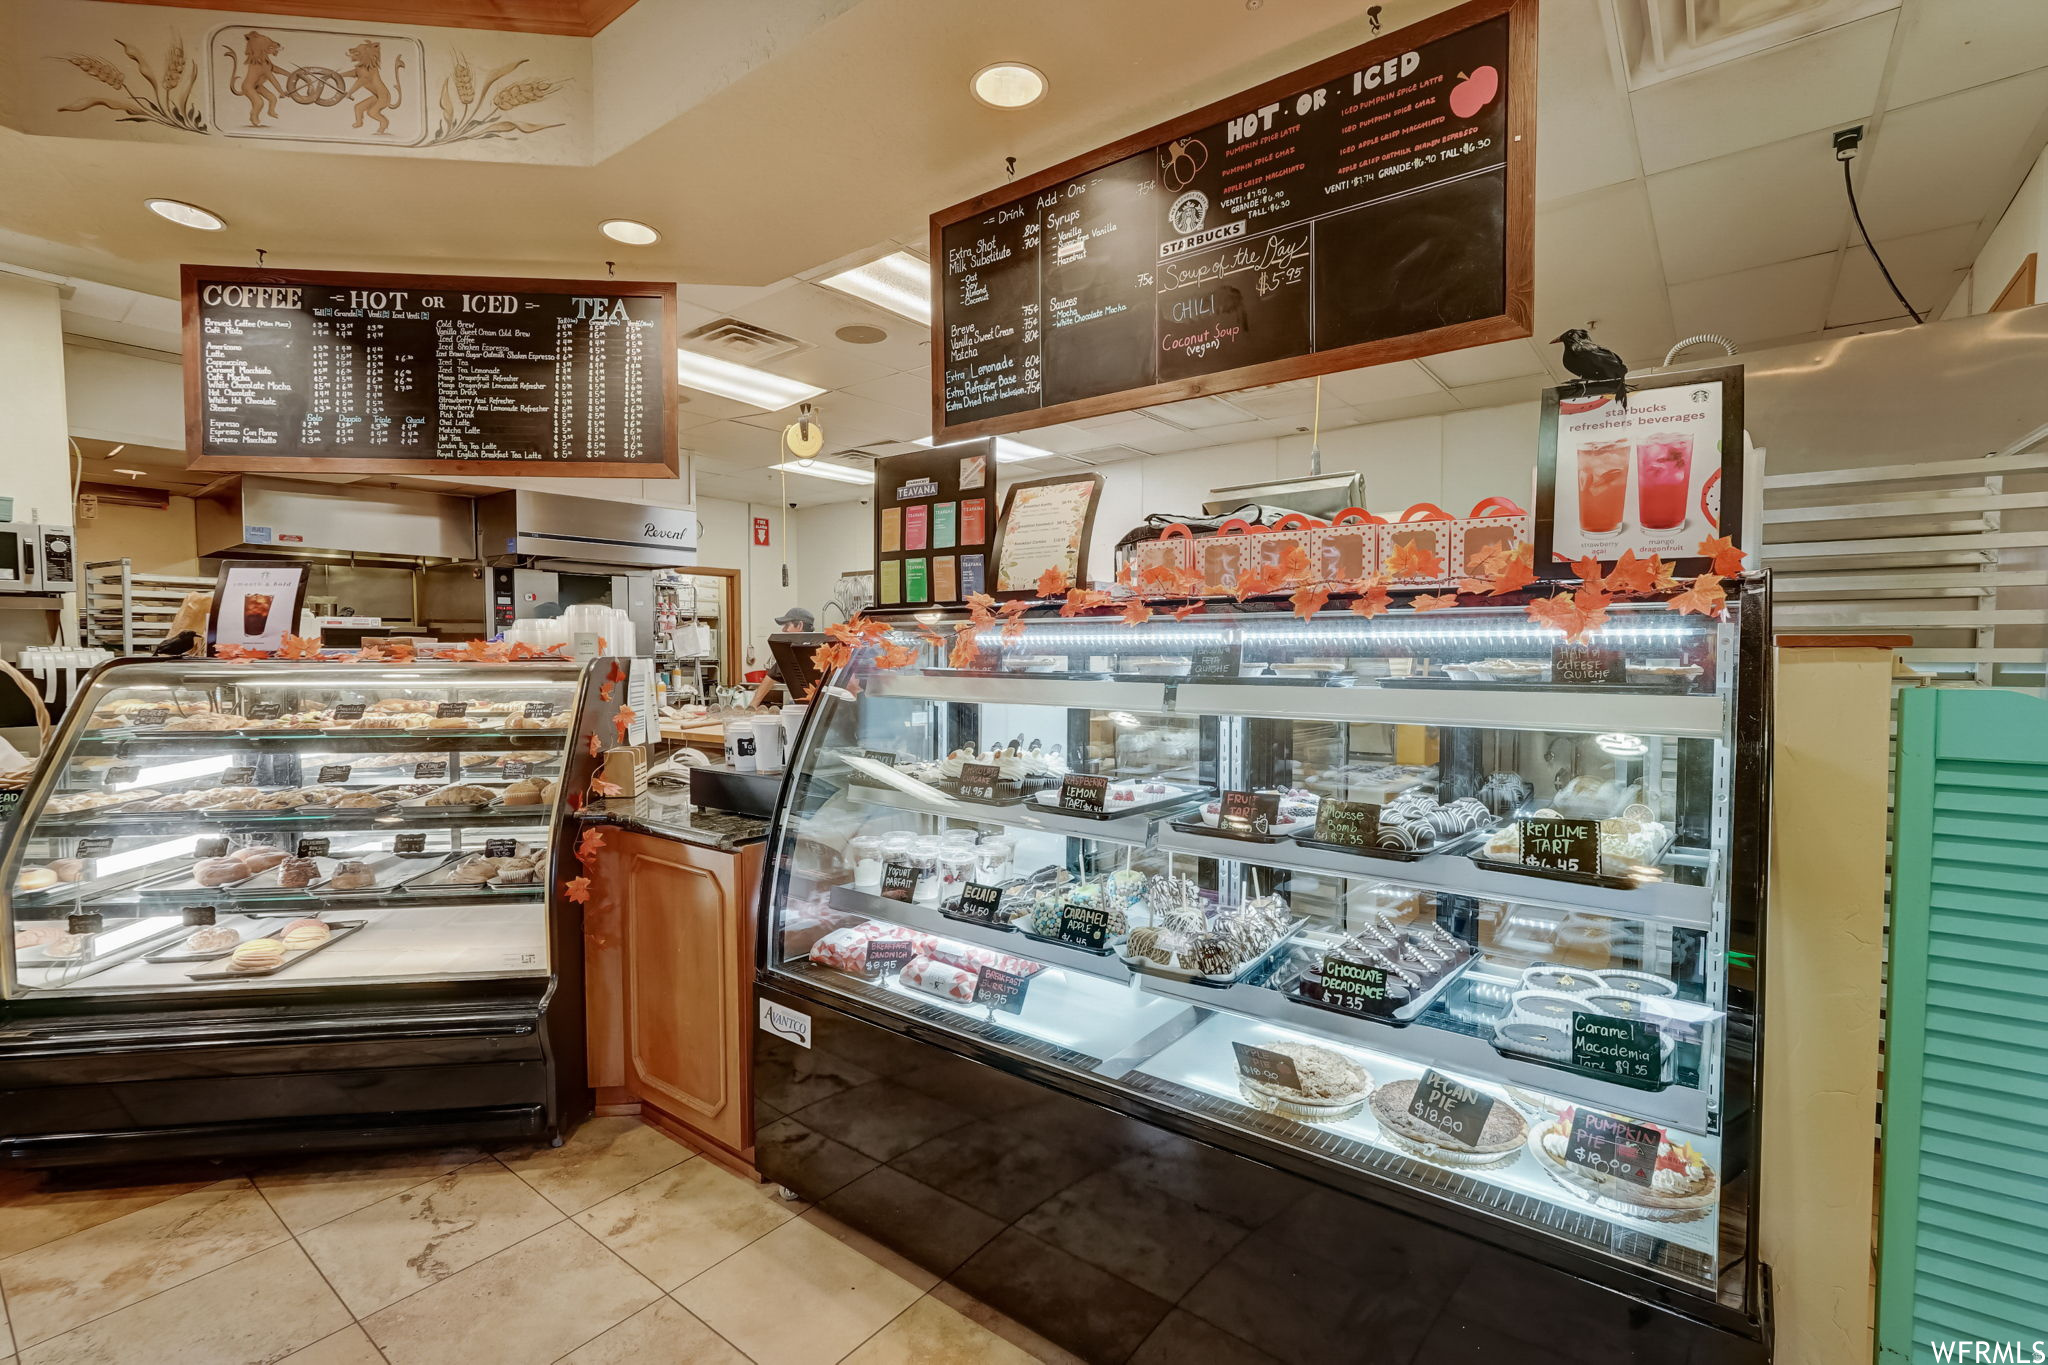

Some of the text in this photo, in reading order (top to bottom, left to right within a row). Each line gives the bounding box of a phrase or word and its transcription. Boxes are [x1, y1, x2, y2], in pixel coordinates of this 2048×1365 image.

[1227, 51, 1421, 145] HOT OR ICED
[1359, 74, 1444, 110] PUMPKIN SPICE LATTE
[1359, 103, 1413, 128] PUMPKIN SPICE
[1225, 123, 1301, 158] PUMPKIN SPICE LATTE
[1358, 116, 1446, 149] APPLE CRISP MACCHIATO
[1381, 126, 1479, 161] OATMILK ESPRESSO
[1222, 153, 1273, 177] PUMPKIN SPICE
[1223, 163, 1306, 194] APPLE CRISP MACCHIATO
[1324, 161, 1412, 195] VENTI GRANDE
[1220, 195, 1243, 209] VENTI
[1231, 198, 1260, 214] GRANDE
[998, 204, 1025, 224] Drink
[1047, 209, 1080, 231] Syrups
[1248, 206, 1267, 219] TALL
[1058, 226, 1082, 241] Vanilla
[1091, 222, 1117, 238] Vanilla
[1162, 223, 1242, 256] STARBUCKS
[949, 235, 997, 263] Extra Shot
[949, 245, 1012, 276] Milk Substitute
[1057, 249, 1087, 267] Hazelnut
[1164, 235, 1308, 291] Soup the Day
[1256, 267, 1304, 296] $5.95
[203, 285, 630, 320] COFFEE HOT OR ICED TEA
[1050, 296, 1078, 312] Sauces
[1172, 294, 1215, 322] CHILI
[1074, 308, 1104, 323] Chocolate
[436, 327, 457, 336] Vanilla
[457, 320, 475, 328] Brew
[951, 324, 976, 337] Breve
[456, 335, 475, 344] Coffee
[950, 325, 1015, 350] Vanilla Sweet Cream
[1162, 323, 1240, 351] Coconut Soup
[206, 342, 242, 351] Americano
[482, 343, 510, 352] Espresso
[950, 346, 978, 363] Matcha
[1186, 338, 1220, 358] (vegan)
[528, 352, 556, 362] Espresso
[470, 366, 500, 374] Lemonade
[946, 354, 1015, 384] Extra Lemonade
[231, 381, 265, 390] Chocolate
[491, 382, 519, 390] Lemonade
[520, 382, 547, 391] Refresher
[492, 374, 519, 383] Refresher
[965, 375, 1017, 396] Refresher Base
[224, 389, 256, 397] Chocolate
[245, 397, 277, 405] Chocolate
[438, 396, 472, 405] Strawberry
[983, 390, 999, 403] Fruit
[439, 404, 550, 413] Strawberry Refresher
[1605, 404, 1667, 418] starbucks
[210, 419, 240, 428] Espresso
[406, 416, 425, 424] Quad
[1569, 411, 1706, 433] refreshers beverages
[457, 450, 542, 460] English Breakfast Latte
[899, 485, 936, 498] TEAVANA
[1639, 545, 1684, 553] dragonfruit
[1648, 539, 1675, 547] mango
[1556, 660, 1601, 670] CHEESE
[1563, 670, 1610, 680] QUICHE
[960, 785, 984, 797] $4.95
[1066, 786, 1097, 798] LEMON
[1065, 797, 1085, 809] TART
[1327, 805, 1365, 820] Mousse
[1327, 819, 1358, 832] Bomb
[1526, 822, 1588, 839] KEY LIME
[1531, 838, 1575, 855] TART
[888, 866, 912, 878] YOGURT
[885, 877, 913, 889] PARFAIT
[963, 886, 998, 904] ECLAIR
[962, 902, 989, 917] $4.50
[1063, 906, 1108, 928] CARAMEL
[1067, 920, 1093, 935] APPLE
[871, 942, 909, 951] BREAKFAST
[870, 950, 908, 960] SANDWICH
[985, 969, 1025, 987] BREAKFAST
[1326, 961, 1383, 984] CHOCOLATE
[981, 979, 1019, 995] BURRITO
[1321, 976, 1385, 1000] DECADENCE
[764, 1006, 807, 1037] AVANTCO
[1575, 1015, 1634, 1041] Caramel
[1574, 1036, 1650, 1062] Macademia
[1426, 1071, 1479, 1105] PECAN
[1428, 1090, 1458, 1112] PIE
[1585, 1114, 1657, 1145] PUMPKIN
[1576, 1128, 1606, 1150] PIE
